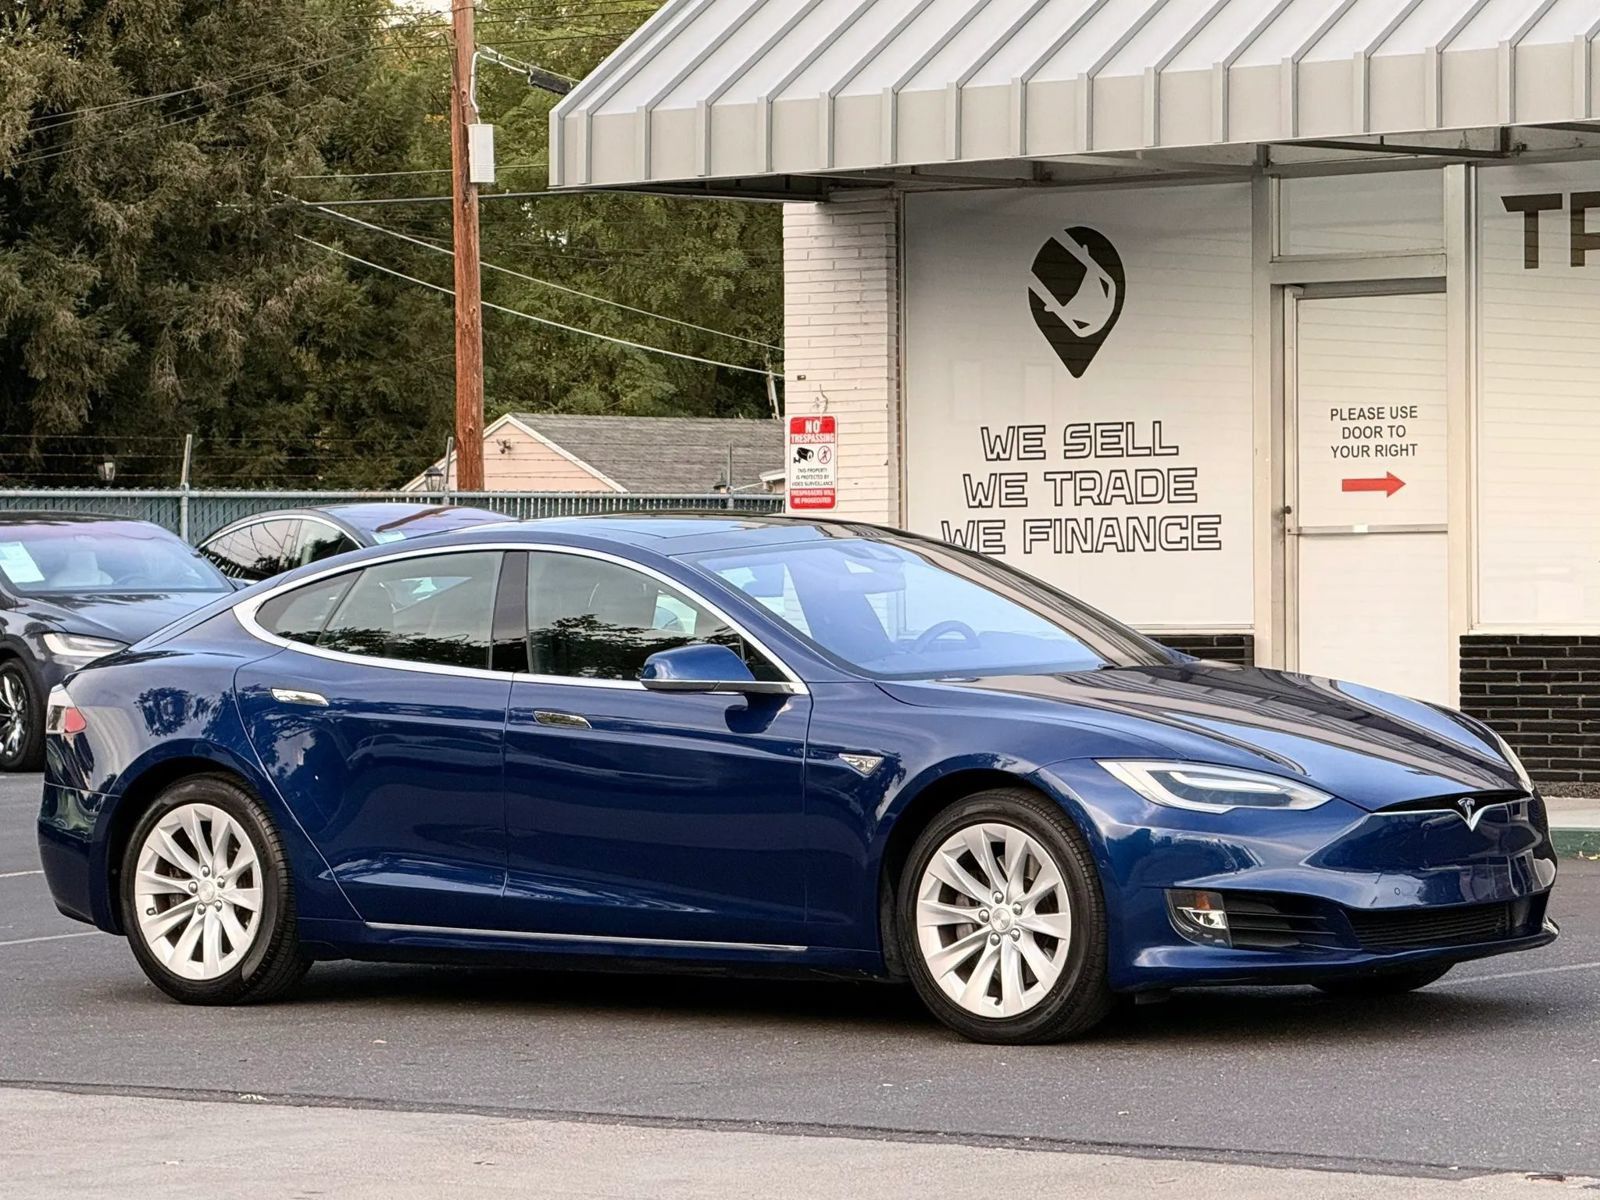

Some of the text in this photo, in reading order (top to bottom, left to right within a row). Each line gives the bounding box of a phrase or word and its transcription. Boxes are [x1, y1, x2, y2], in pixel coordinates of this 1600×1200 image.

[1330, 405, 1418, 421] PLEASE USE
[805, 419, 820, 434] NO
[1342, 424, 1406, 439] DOOR TO
[980, 421, 1179, 461] WE SELL
[1331, 443, 1418, 458] YOUR RIGHT
[963, 467, 1198, 508] WE TRADE
[941, 514, 1222, 554] WE FINANCE
